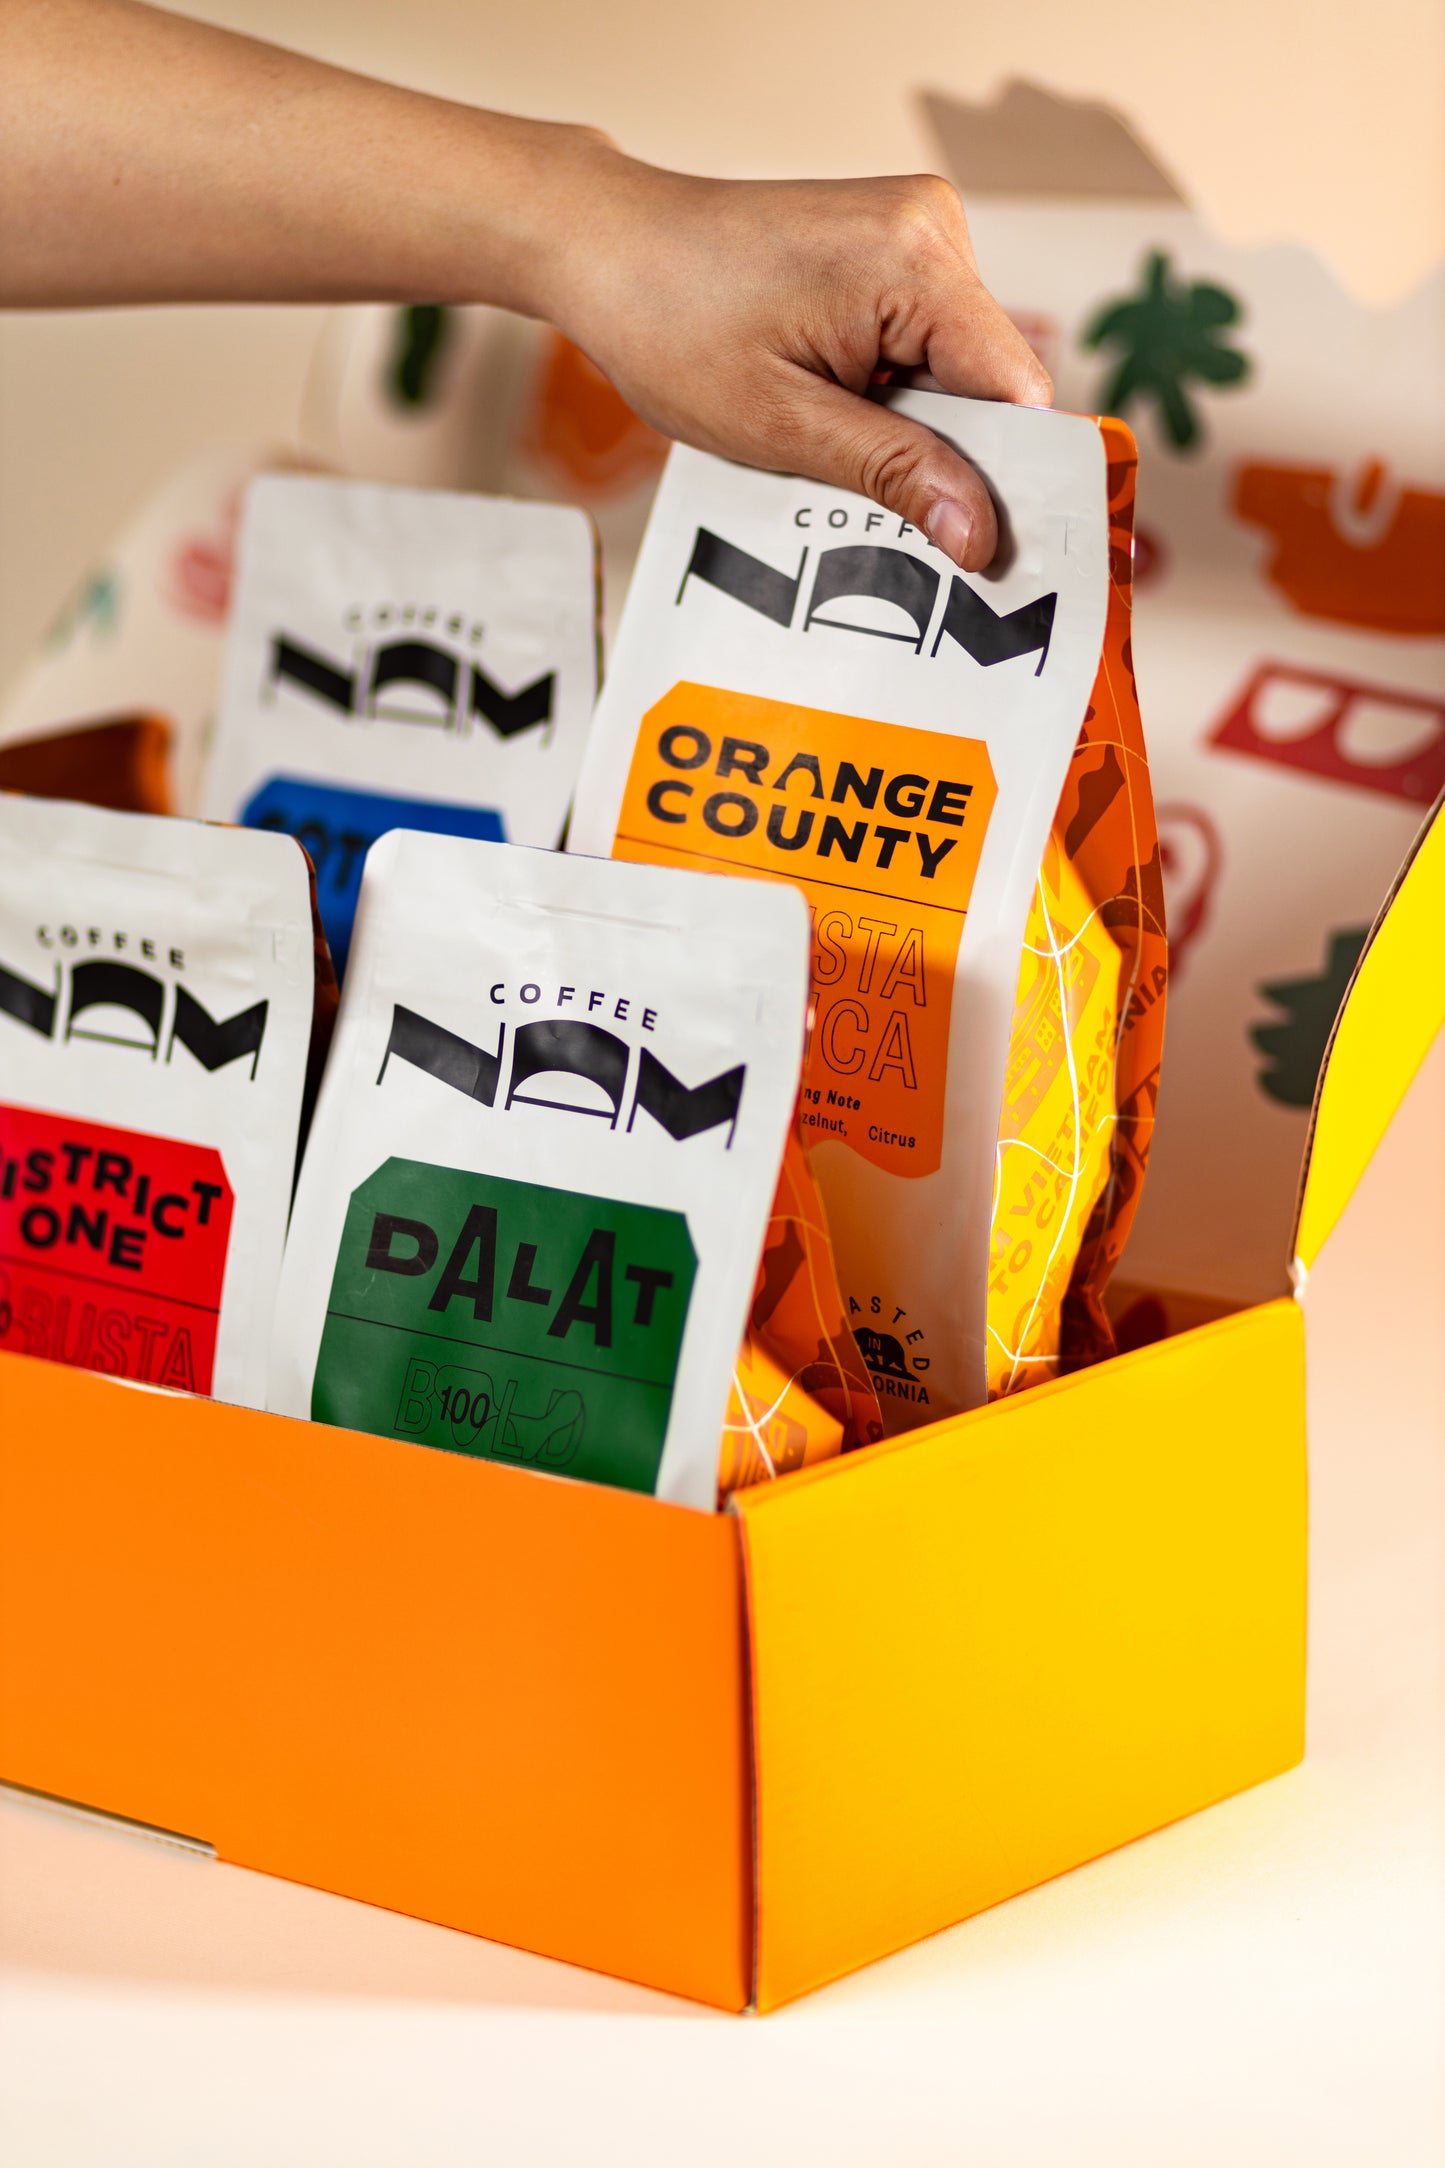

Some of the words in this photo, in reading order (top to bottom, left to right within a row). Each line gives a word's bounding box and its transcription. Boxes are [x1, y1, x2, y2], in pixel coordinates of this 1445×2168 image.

[794, 508, 935, 546] COFF
[676, 526, 1057, 677] NAM
[657, 725, 974, 827] ORANGE
[646, 779, 959, 880] COUNTY
[36, 924, 187, 970] COFFEE
[808, 904, 927, 1008] STA
[488, 982, 659, 1032] COFFEE
[376, 1003, 747, 1151] NAM
[826, 1089, 862, 1112] Note
[1008, 1005, 1114, 1219] VIETNAM
[802, 1112, 848, 1138] zelnut,
[868, 1125, 916, 1149] Citrus
[0, 1140, 223, 1240] ISTRICT
[20, 1202, 148, 1273] ONE
[988, 1239, 1033, 1298] TO
[365, 1204, 674, 1348] DALAT
[0, 1265, 197, 1394] BUSTA
[848, 1295, 931, 1371] ASTED
[867, 1335, 881, 1351] IN
[440, 1385, 490, 1429] 100
[872, 1375, 930, 1405] ORNIA
